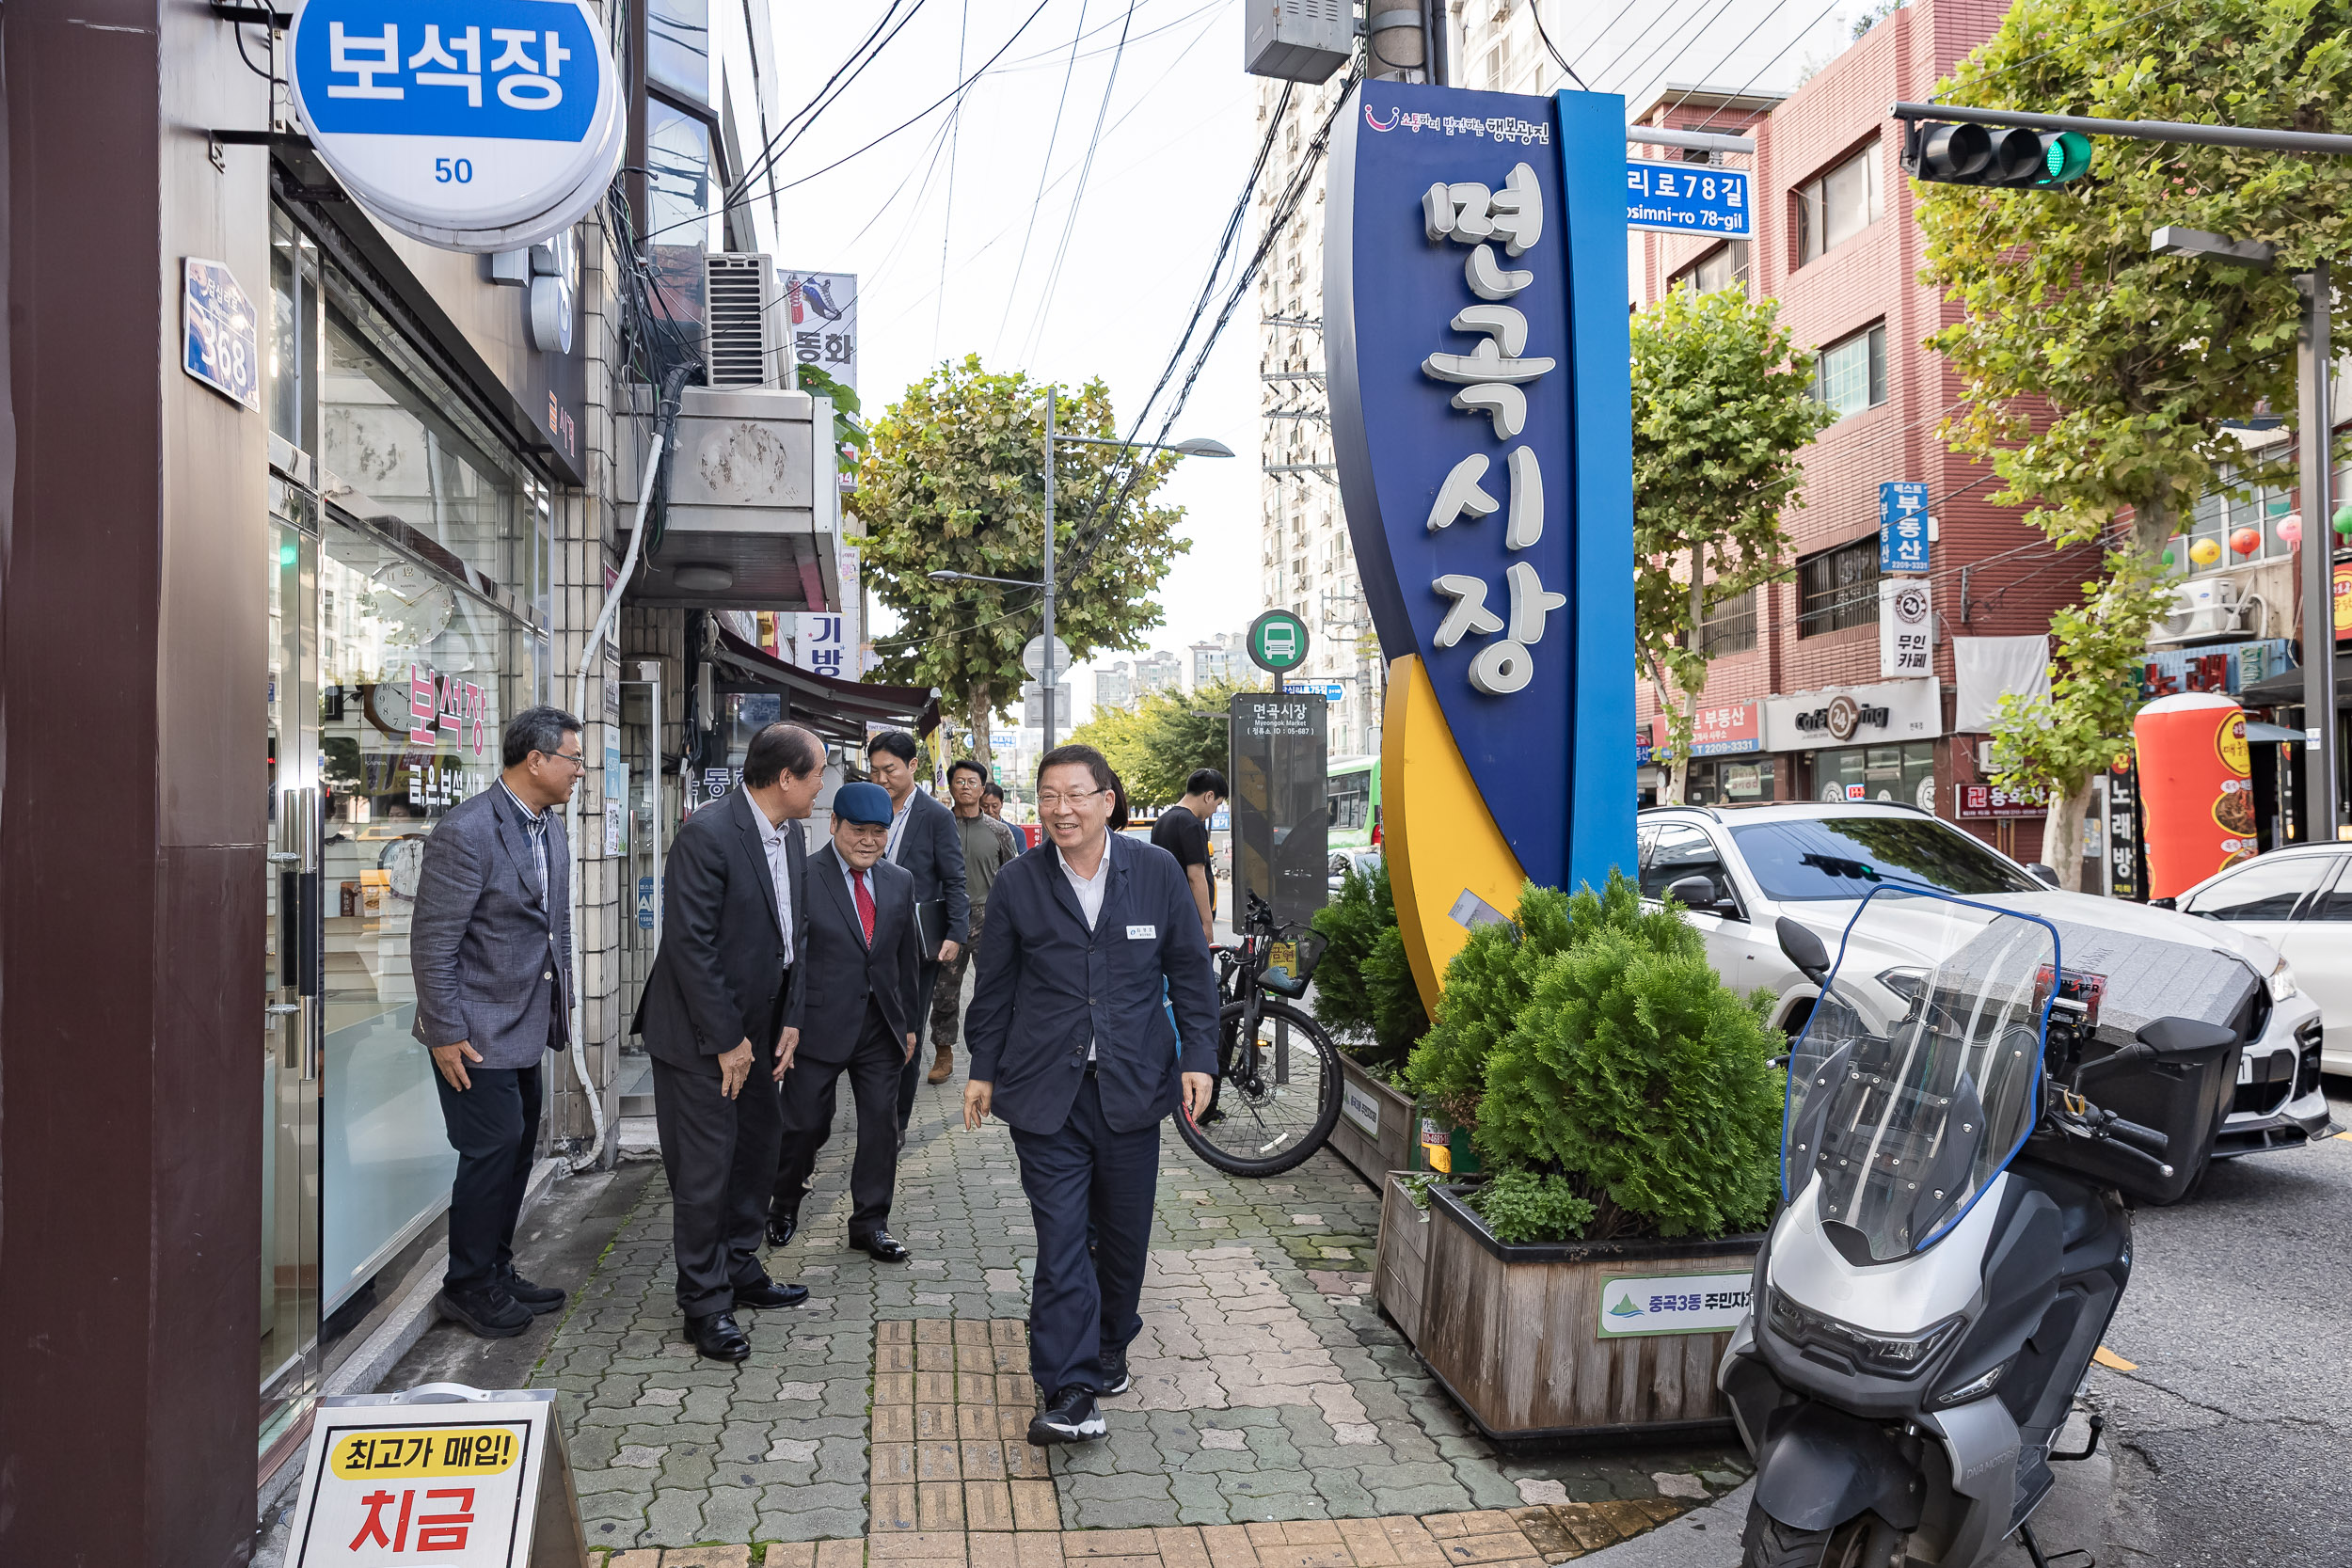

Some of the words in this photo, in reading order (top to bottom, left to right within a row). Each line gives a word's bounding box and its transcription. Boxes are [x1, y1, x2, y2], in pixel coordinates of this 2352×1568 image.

[327, 22, 570, 110] 보석장
[1401, 113, 1440, 134] 소통하며
[1443, 117, 1485, 136] 발전하는
[1486, 117, 1549, 145] 행복광진
[435, 157, 472, 183] 50
[1700, 210, 1742, 231] 78-gil
[201, 315, 247, 388] 368
[1422, 162, 1566, 693] 면곡시장
[1893, 483, 1923, 495] 베스트
[1896, 495, 1923, 561] 부동산
[1905, 599, 1918, 613] 24
[1898, 635, 1927, 650] 무인
[1898, 653, 1927, 668] 카페
[411, 663, 486, 756] 보석장
[1253, 704, 1308, 721] 면곡시장
[1705, 705, 1745, 731] 부동산
[1254, 720, 1285, 728] Myeongok
[1696, 745, 1703, 754] T
[1705, 740, 1753, 753] 2209-3331
[2111, 780, 2132, 879] 노래방
[1313, 1035, 1332, 1065] KENDA
[1649, 1293, 1701, 1313] 중곡3동
[345, 1437, 434, 1470] 최고가
[443, 1434, 512, 1467] 매입!
[349, 1488, 475, 1553] 치금
